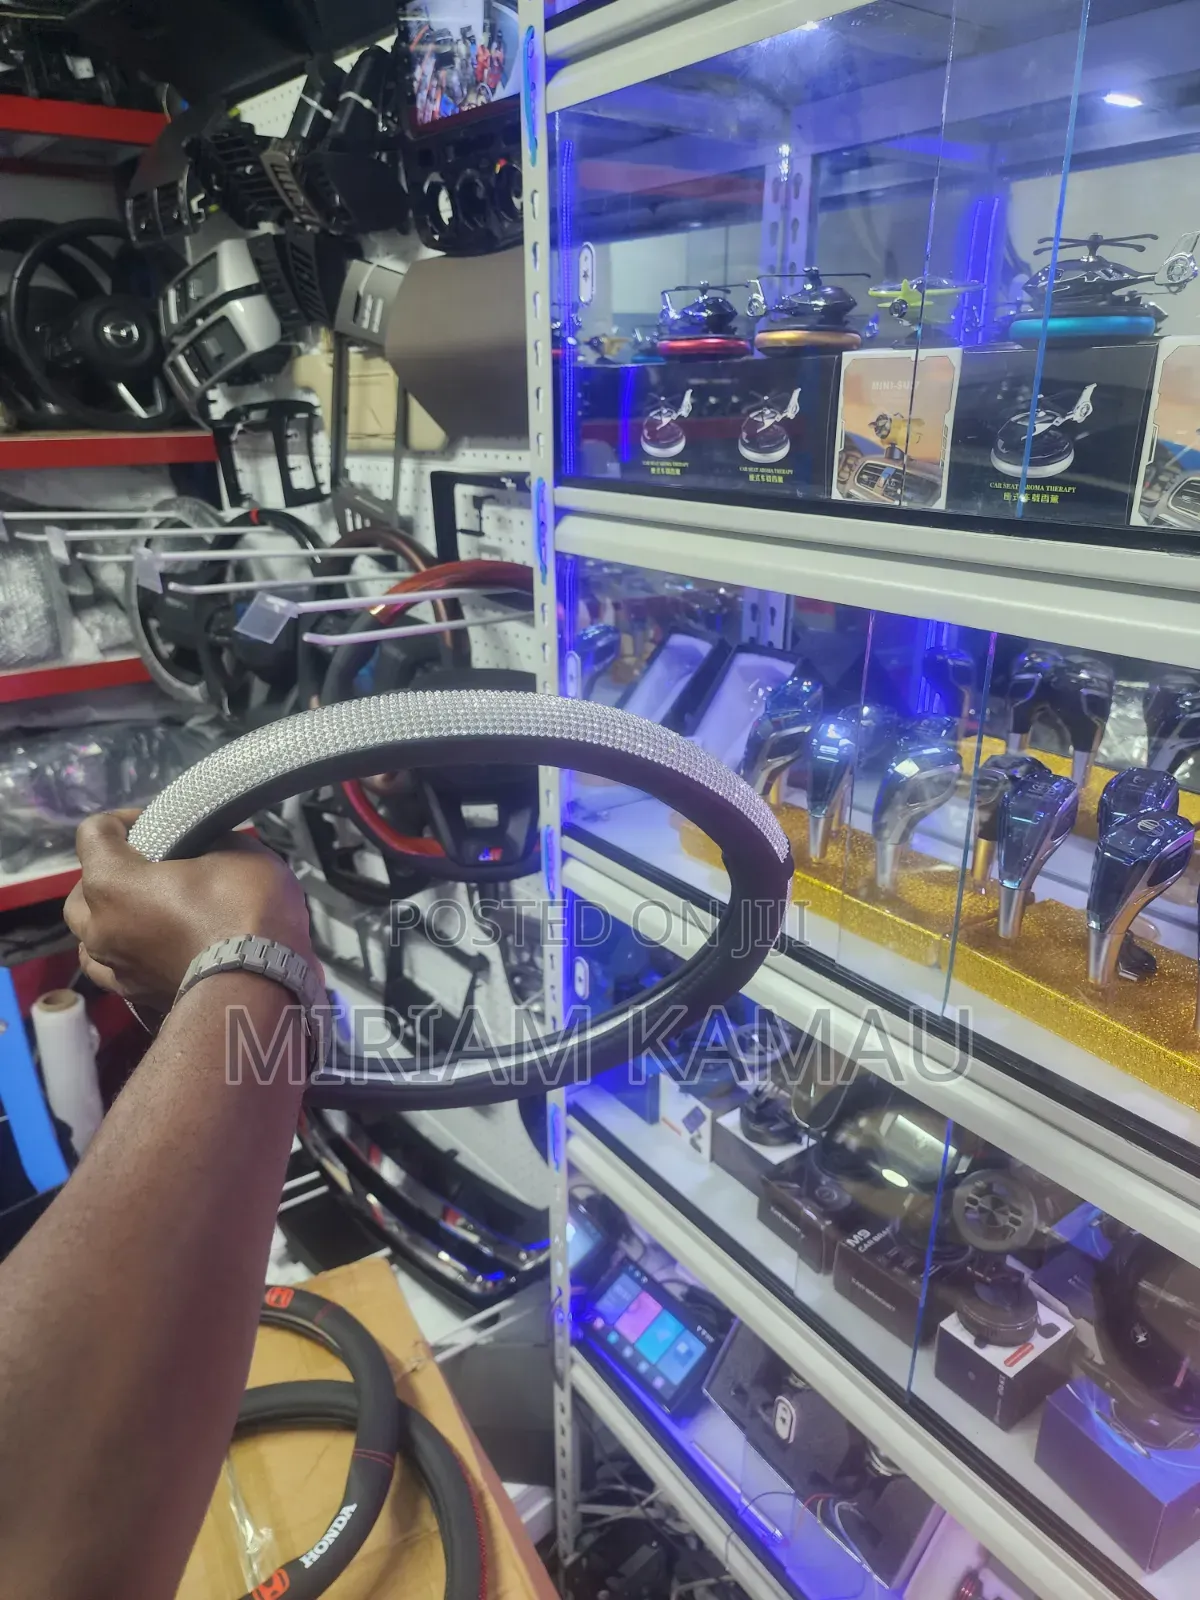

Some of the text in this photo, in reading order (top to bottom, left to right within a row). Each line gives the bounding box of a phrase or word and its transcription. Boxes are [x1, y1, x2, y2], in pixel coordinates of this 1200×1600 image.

[1003, 482, 1019, 490] SEAT
[1021, 484, 1045, 492] ROMA
[1046, 485, 1077, 493] THERAPY
[845, 1228, 871, 1248] M9
[858, 1239, 875, 1253] CAR
[299, 1503, 358, 1569] HONDA
